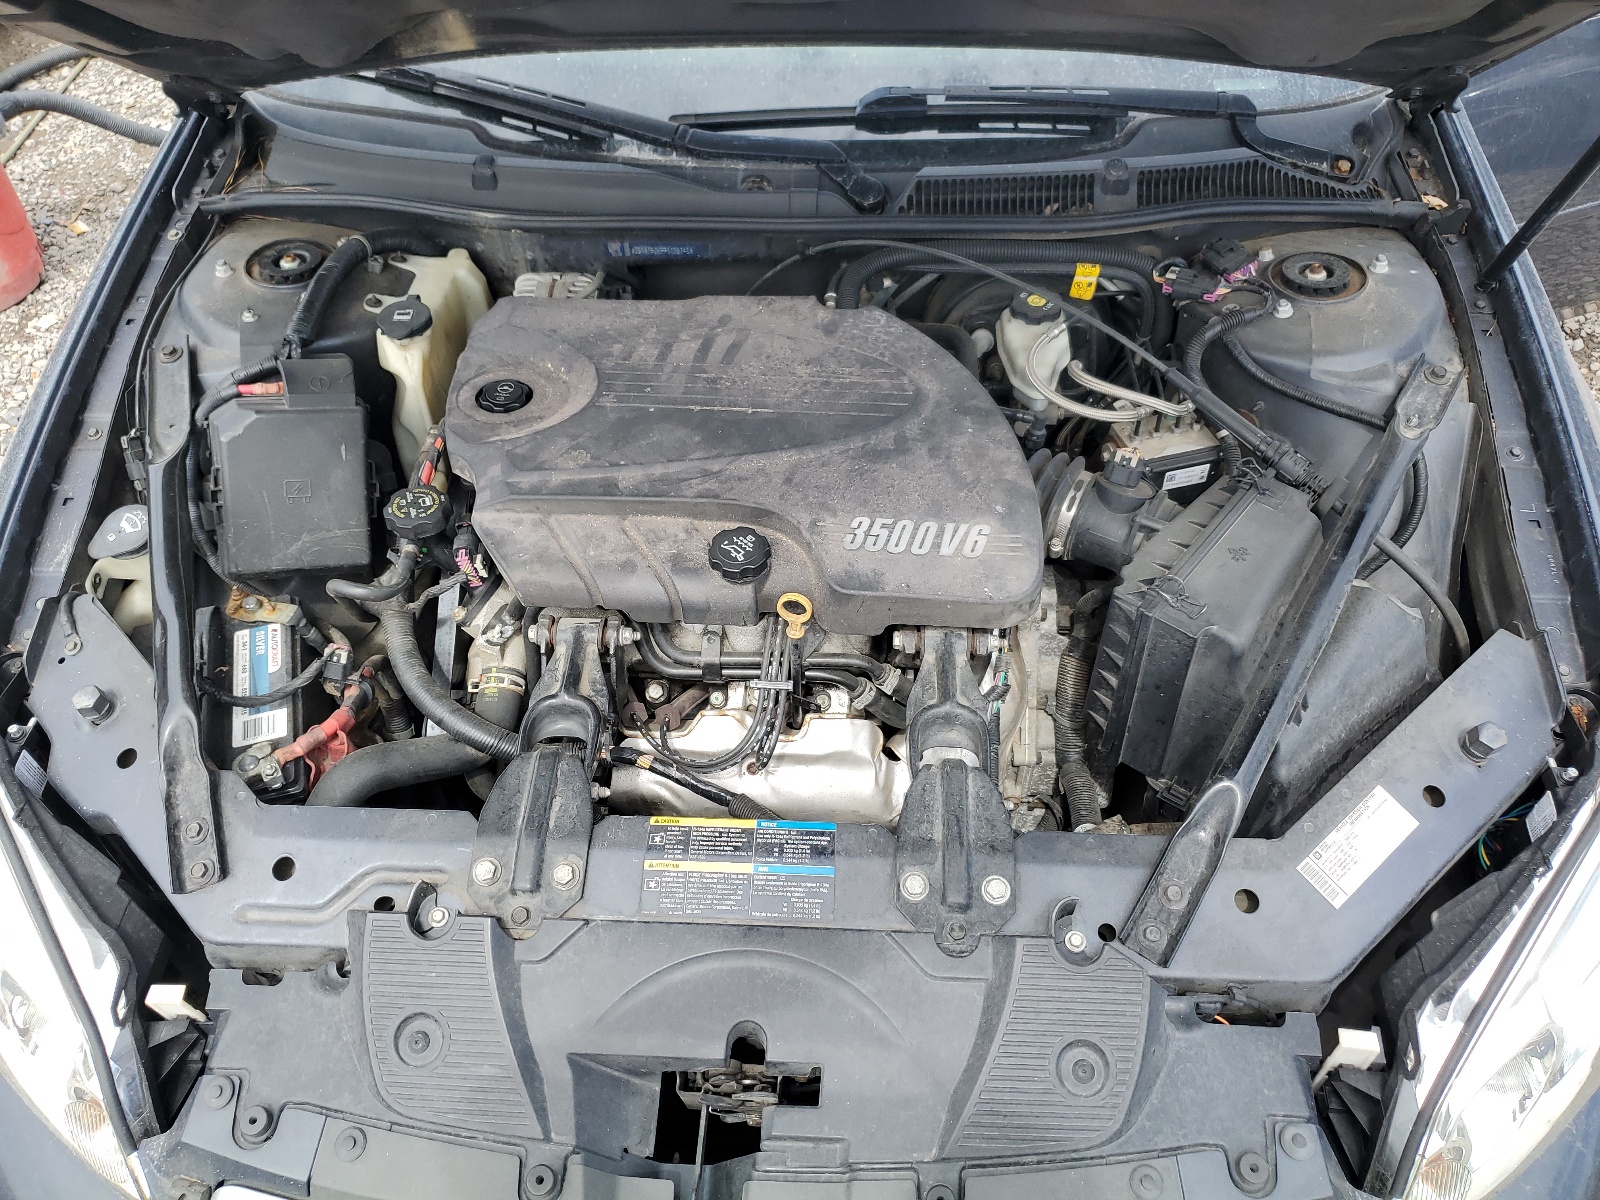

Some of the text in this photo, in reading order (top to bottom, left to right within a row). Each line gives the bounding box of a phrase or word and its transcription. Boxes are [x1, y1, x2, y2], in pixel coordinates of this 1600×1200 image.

[842, 517, 991, 558] 3500 V6
[256, 630, 265, 656] SILVER
